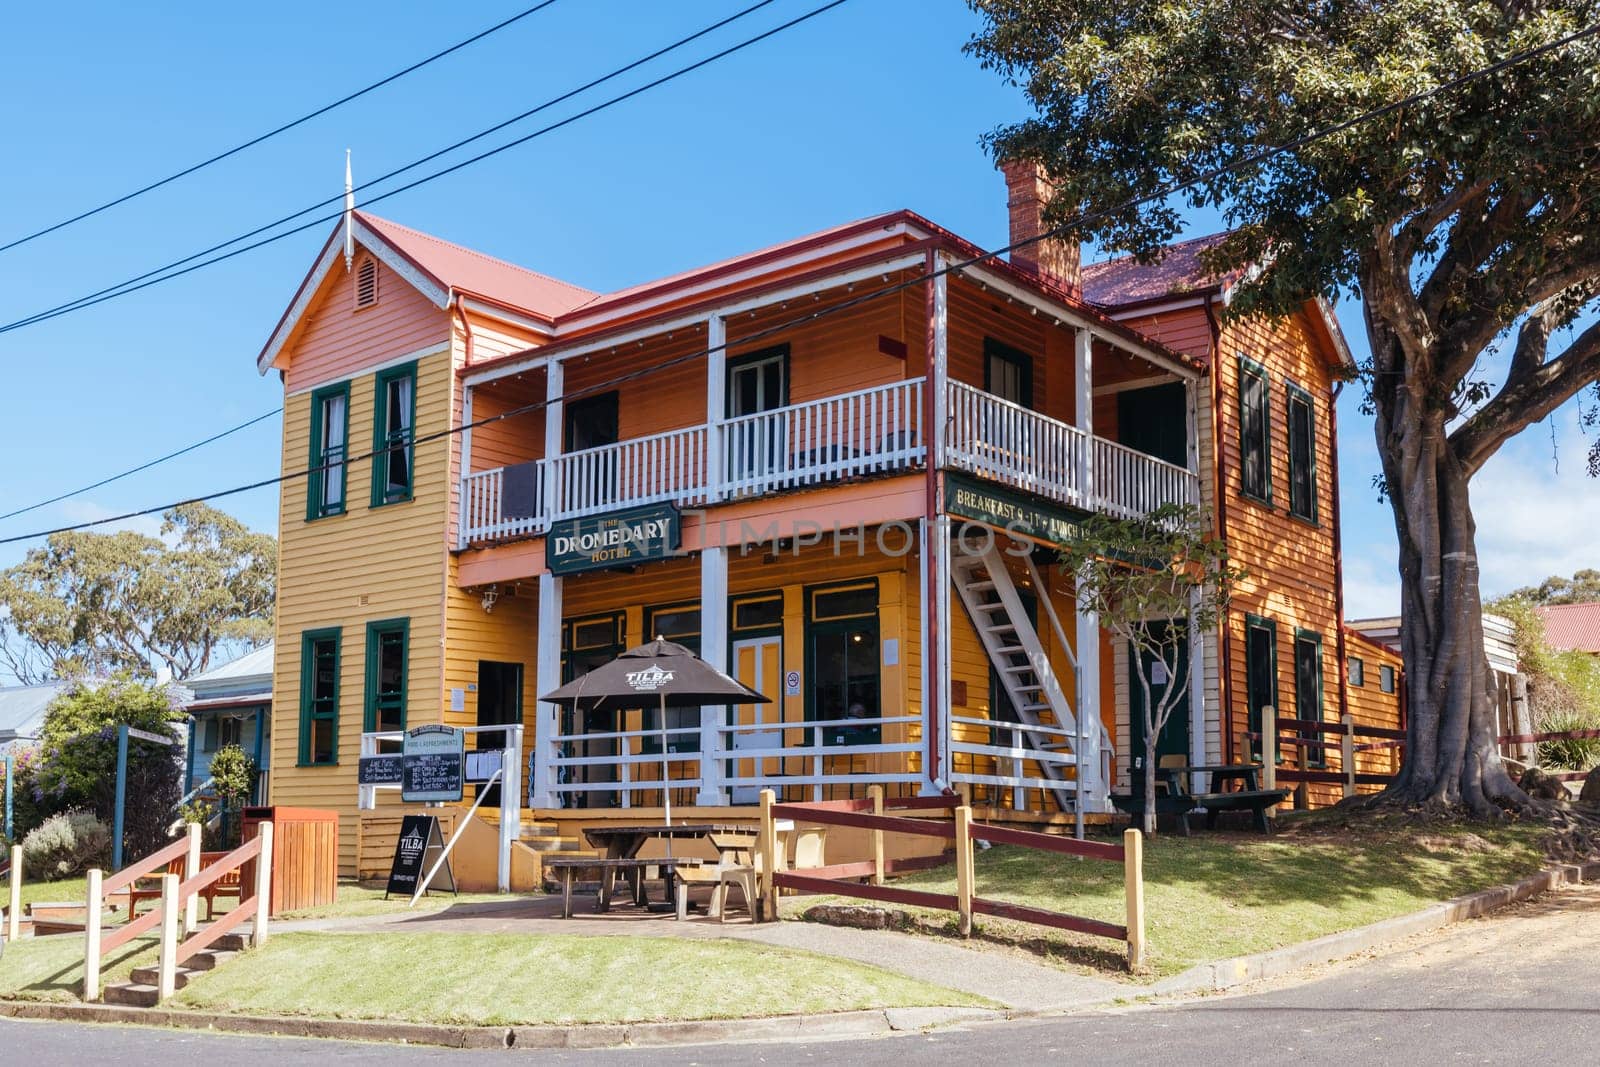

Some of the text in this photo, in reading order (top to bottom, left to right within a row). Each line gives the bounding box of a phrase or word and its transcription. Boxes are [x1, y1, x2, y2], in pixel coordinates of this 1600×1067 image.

[957, 489, 1016, 520] BREAKFAST
[1050, 518, 1078, 538] LUNCH
[603, 519, 619, 527] THE
[554, 518, 671, 556] DROMEDARY
[591, 548, 632, 563] HOTEL
[625, 672, 674, 681] TILBA
[401, 838, 423, 850] TILBA
